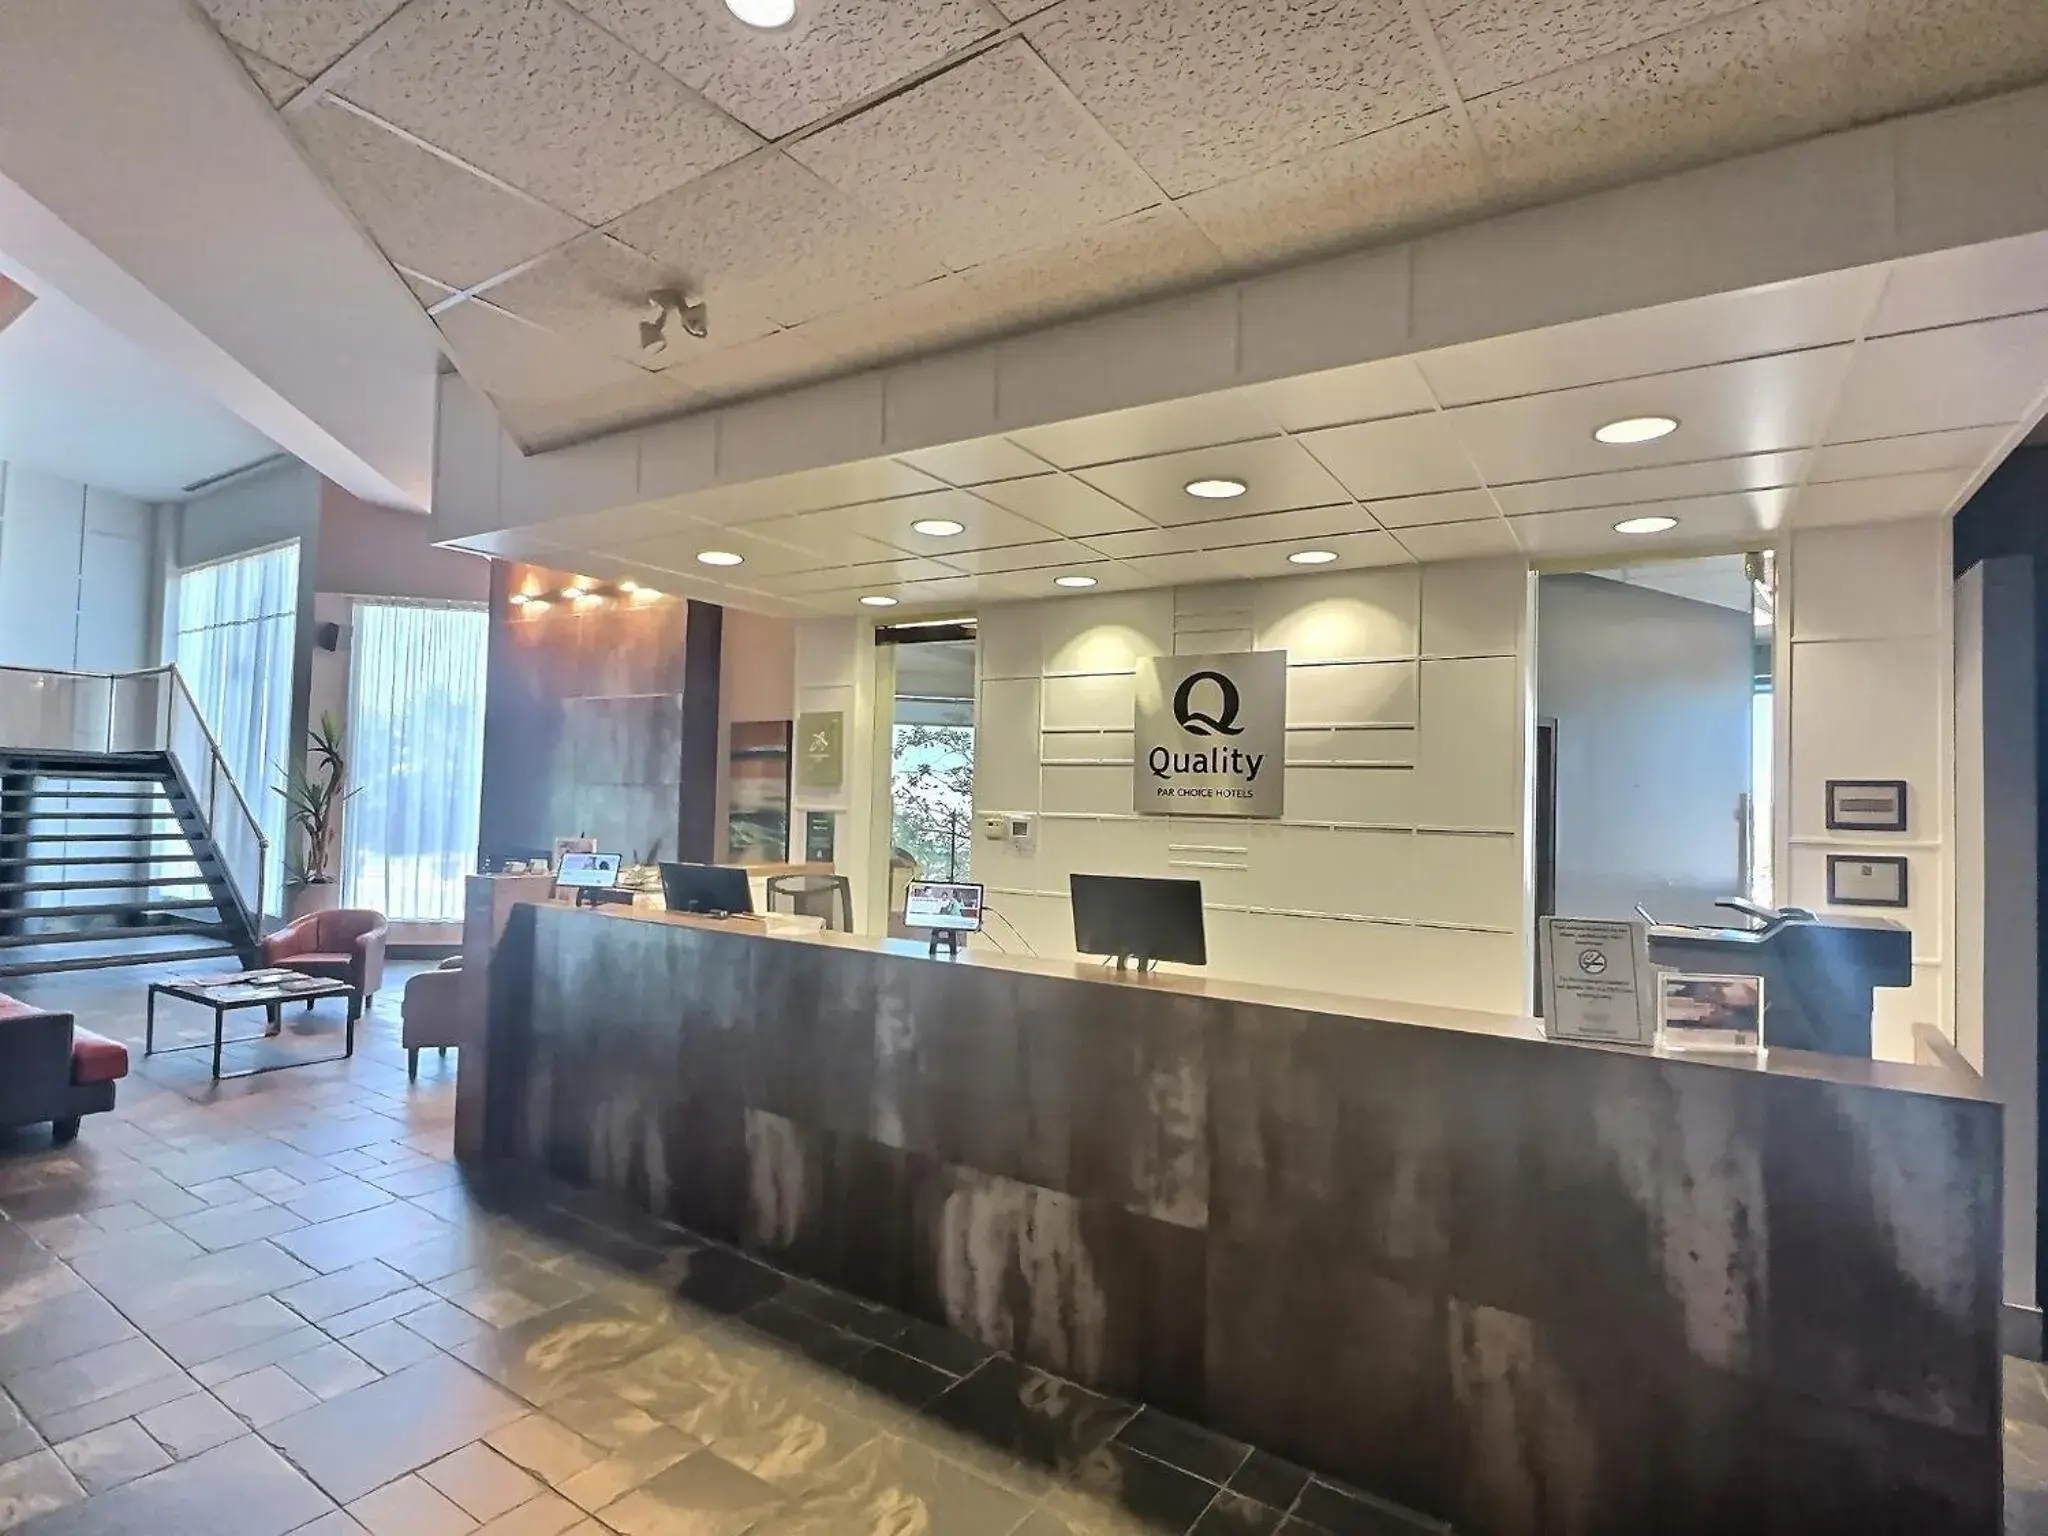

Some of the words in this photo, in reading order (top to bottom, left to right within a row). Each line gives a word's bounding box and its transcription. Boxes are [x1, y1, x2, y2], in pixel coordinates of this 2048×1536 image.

[1173, 671, 1245, 736] Q
[1149, 746, 1264, 781] Quality
[1157, 787, 1175, 797] PAR
[1177, 788, 1213, 797] CHOICE
[1216, 788, 1254, 798] HOTELS
